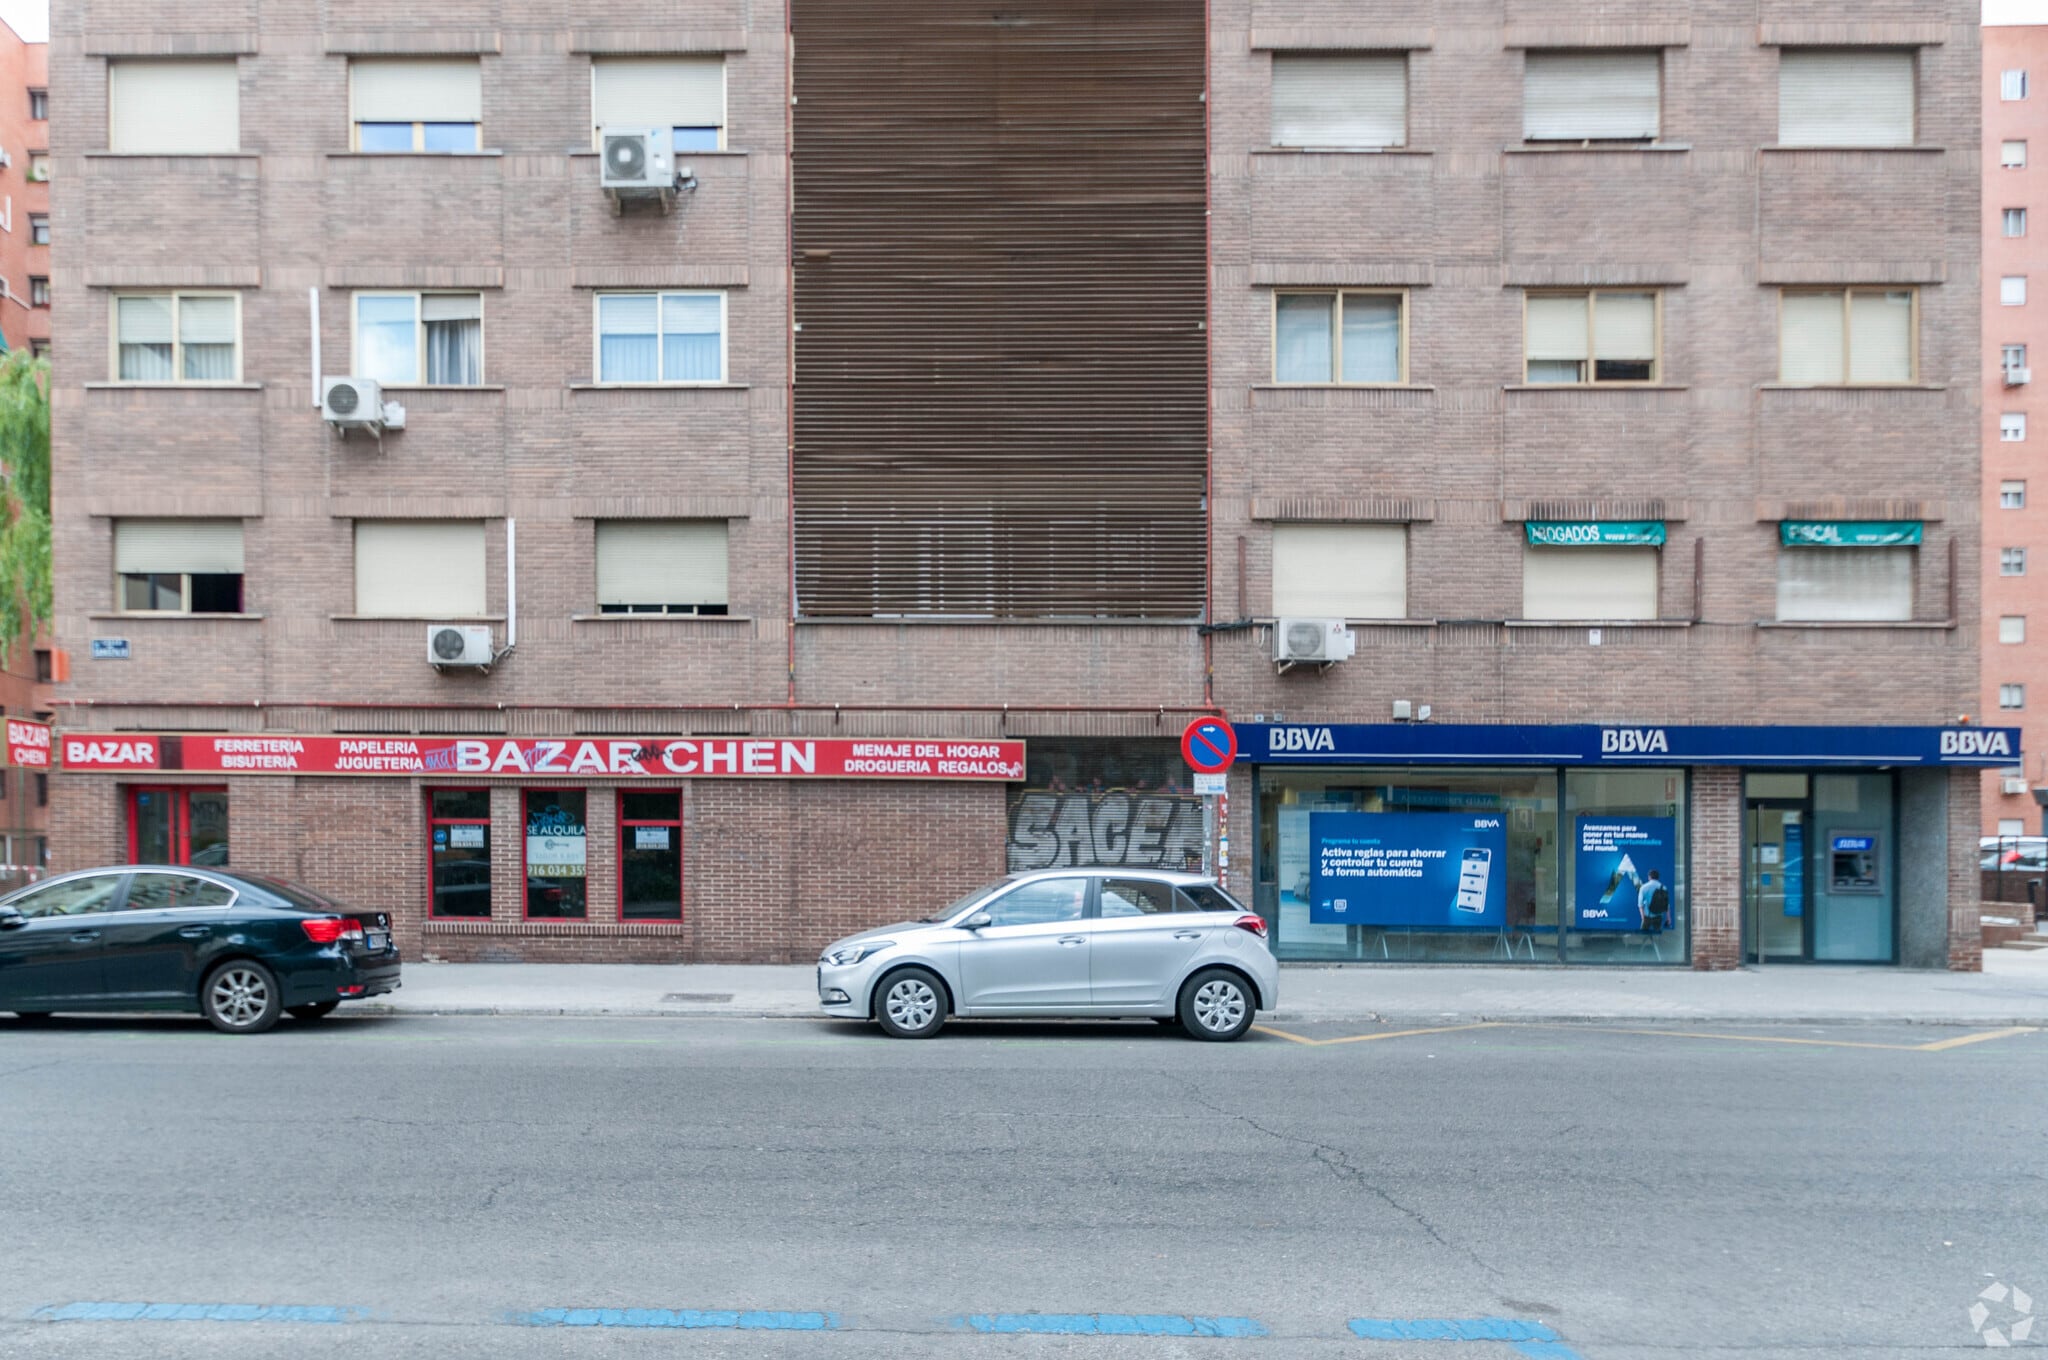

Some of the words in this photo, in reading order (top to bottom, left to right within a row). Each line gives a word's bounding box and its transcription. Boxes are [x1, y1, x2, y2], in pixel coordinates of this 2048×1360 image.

[8, 722, 50, 748] BAZAR
[1269, 728, 1335, 751] BBVA
[1601, 729, 1669, 753] BBVA
[214, 739, 304, 753] FERRETERIA
[340, 741, 418, 754] PAPELERIA
[1940, 731, 2011, 755] BBVA
[14, 747, 47, 765] CHEN
[67, 741, 154, 763] BAZAR
[456, 741, 648, 773] BAZAR
[662, 741, 815, 774] CHEN
[852, 744, 911, 757] MENAJE
[915, 745, 944, 757] DEL
[947, 745, 1001, 758] HOGAR
[221, 754, 298, 768] BISUTERIA
[334, 756, 424, 770] JUGUETERIA
[844, 760, 931, 773] DROGUERIA
[938, 761, 1008, 774] REGALOS
[527, 825, 538, 836] SE
[540, 825, 586, 836] ALQUILA
[1474, 819, 1500, 828] BBVA
[1321, 847, 1352, 857] Activa
[1354, 847, 1384, 859] reglas
[1386, 849, 1408, 859] para
[1410, 848, 1446, 858] ahorrar
[1321, 859, 1327, 868] y
[1329, 858, 1374, 867] controlar
[1376, 858, 1387, 867] tu
[1389, 859, 1423, 868] cuenta
[527, 865, 545, 877] 916
[547, 865, 567, 877] 034
[1321, 867, 1334, 877] de
[1335, 867, 1365, 877] forma
[1367, 867, 1423, 878] automática
[1583, 909, 1608, 918] BBVA
